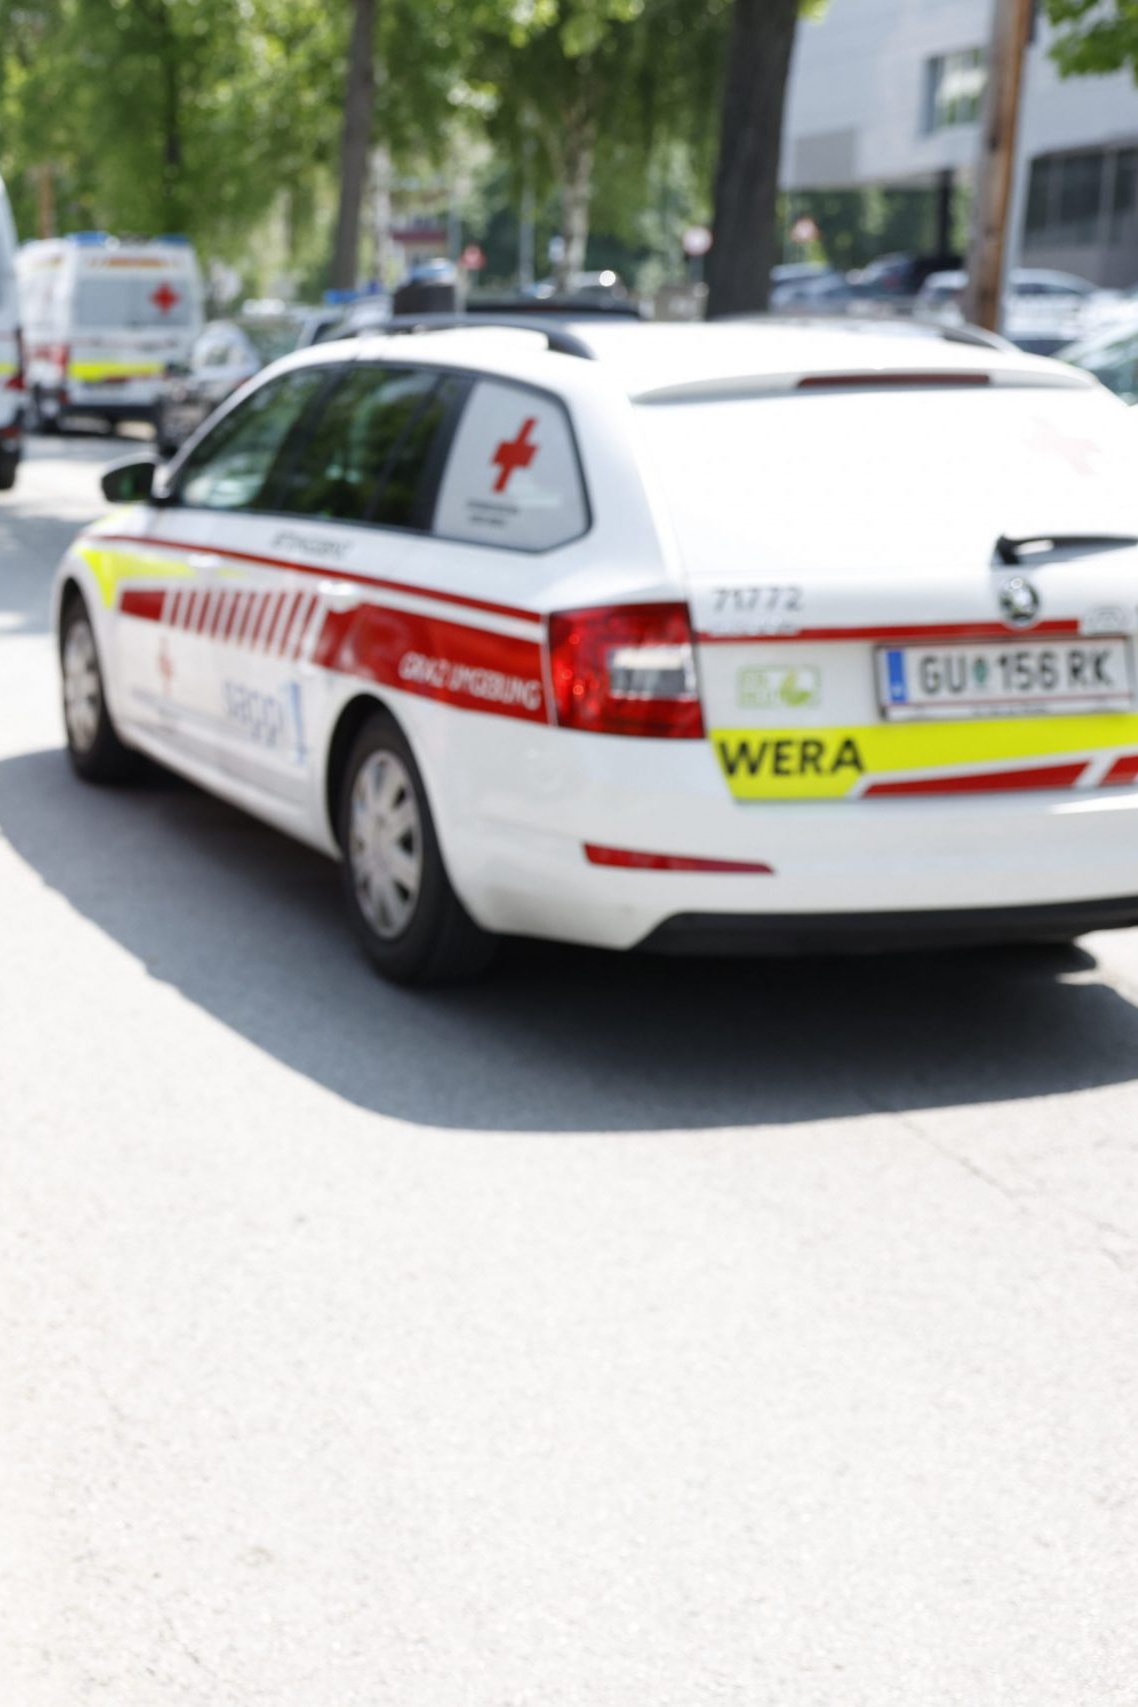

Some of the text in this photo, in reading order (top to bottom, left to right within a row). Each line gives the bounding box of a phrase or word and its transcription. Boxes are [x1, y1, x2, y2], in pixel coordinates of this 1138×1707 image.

[712, 584, 804, 613] 71772
[919, 655, 968, 695] GU
[999, 650, 1060, 691] 156
[1066, 646, 1113, 687] RK
[718, 737, 867, 777] WERA
